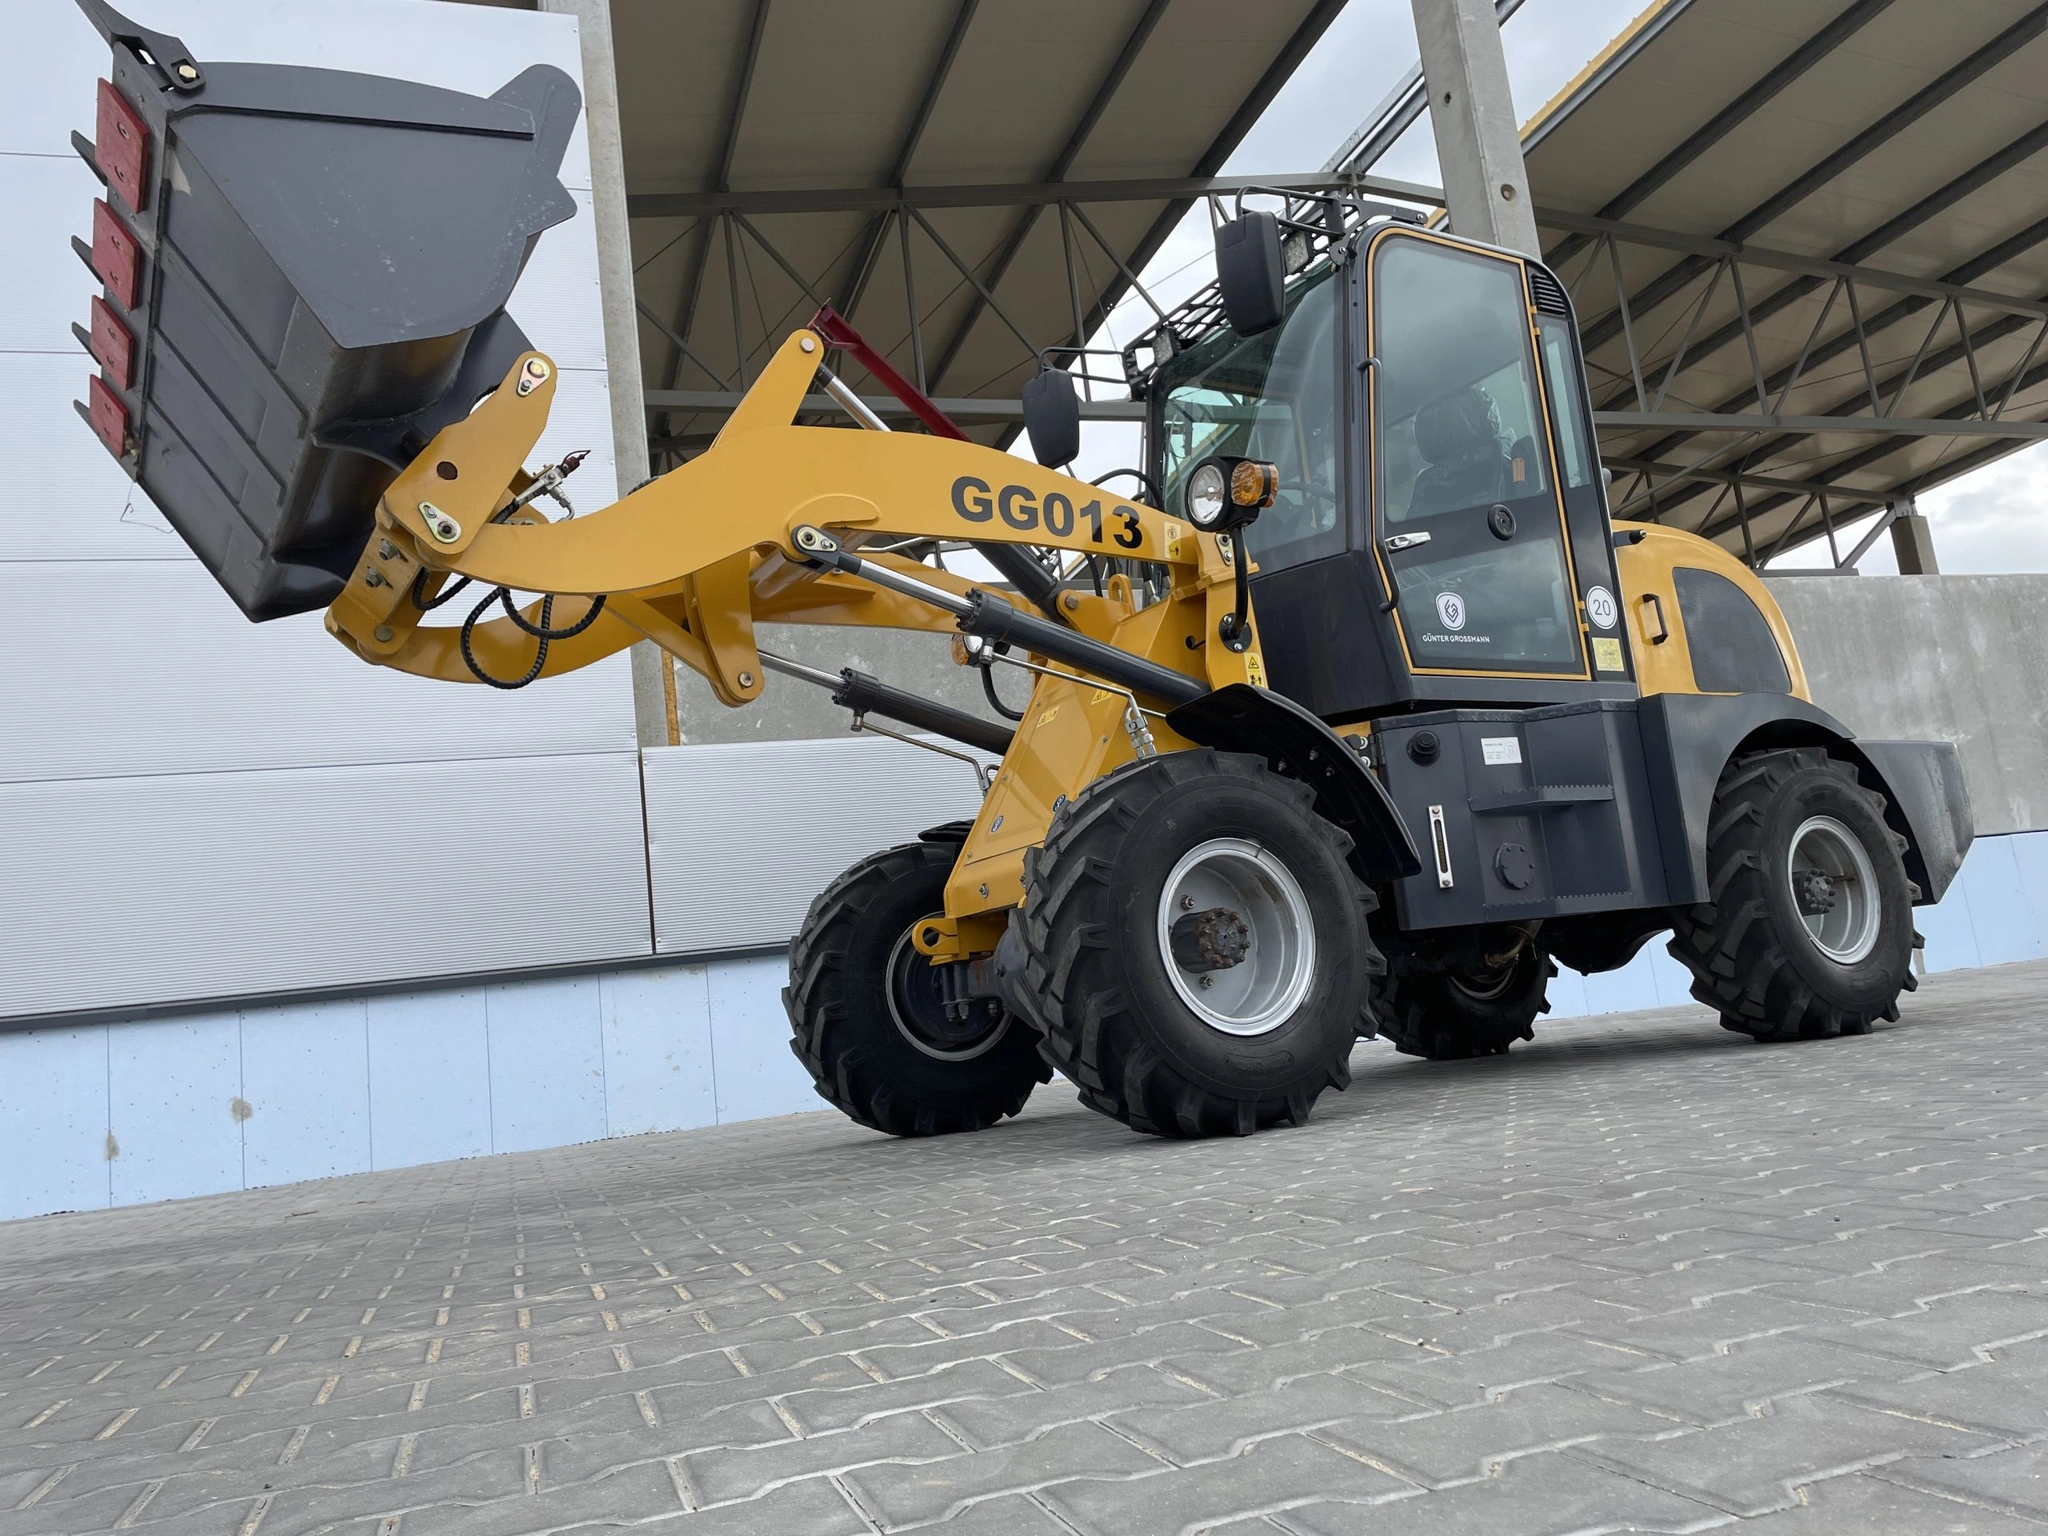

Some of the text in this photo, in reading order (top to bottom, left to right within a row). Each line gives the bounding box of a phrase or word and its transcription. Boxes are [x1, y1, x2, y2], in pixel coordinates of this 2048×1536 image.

[951, 476, 1143, 549] GG013
[1593, 599, 1611, 616] 20
[1422, 632, 1490, 643] GÜNTER GROSSMANN
